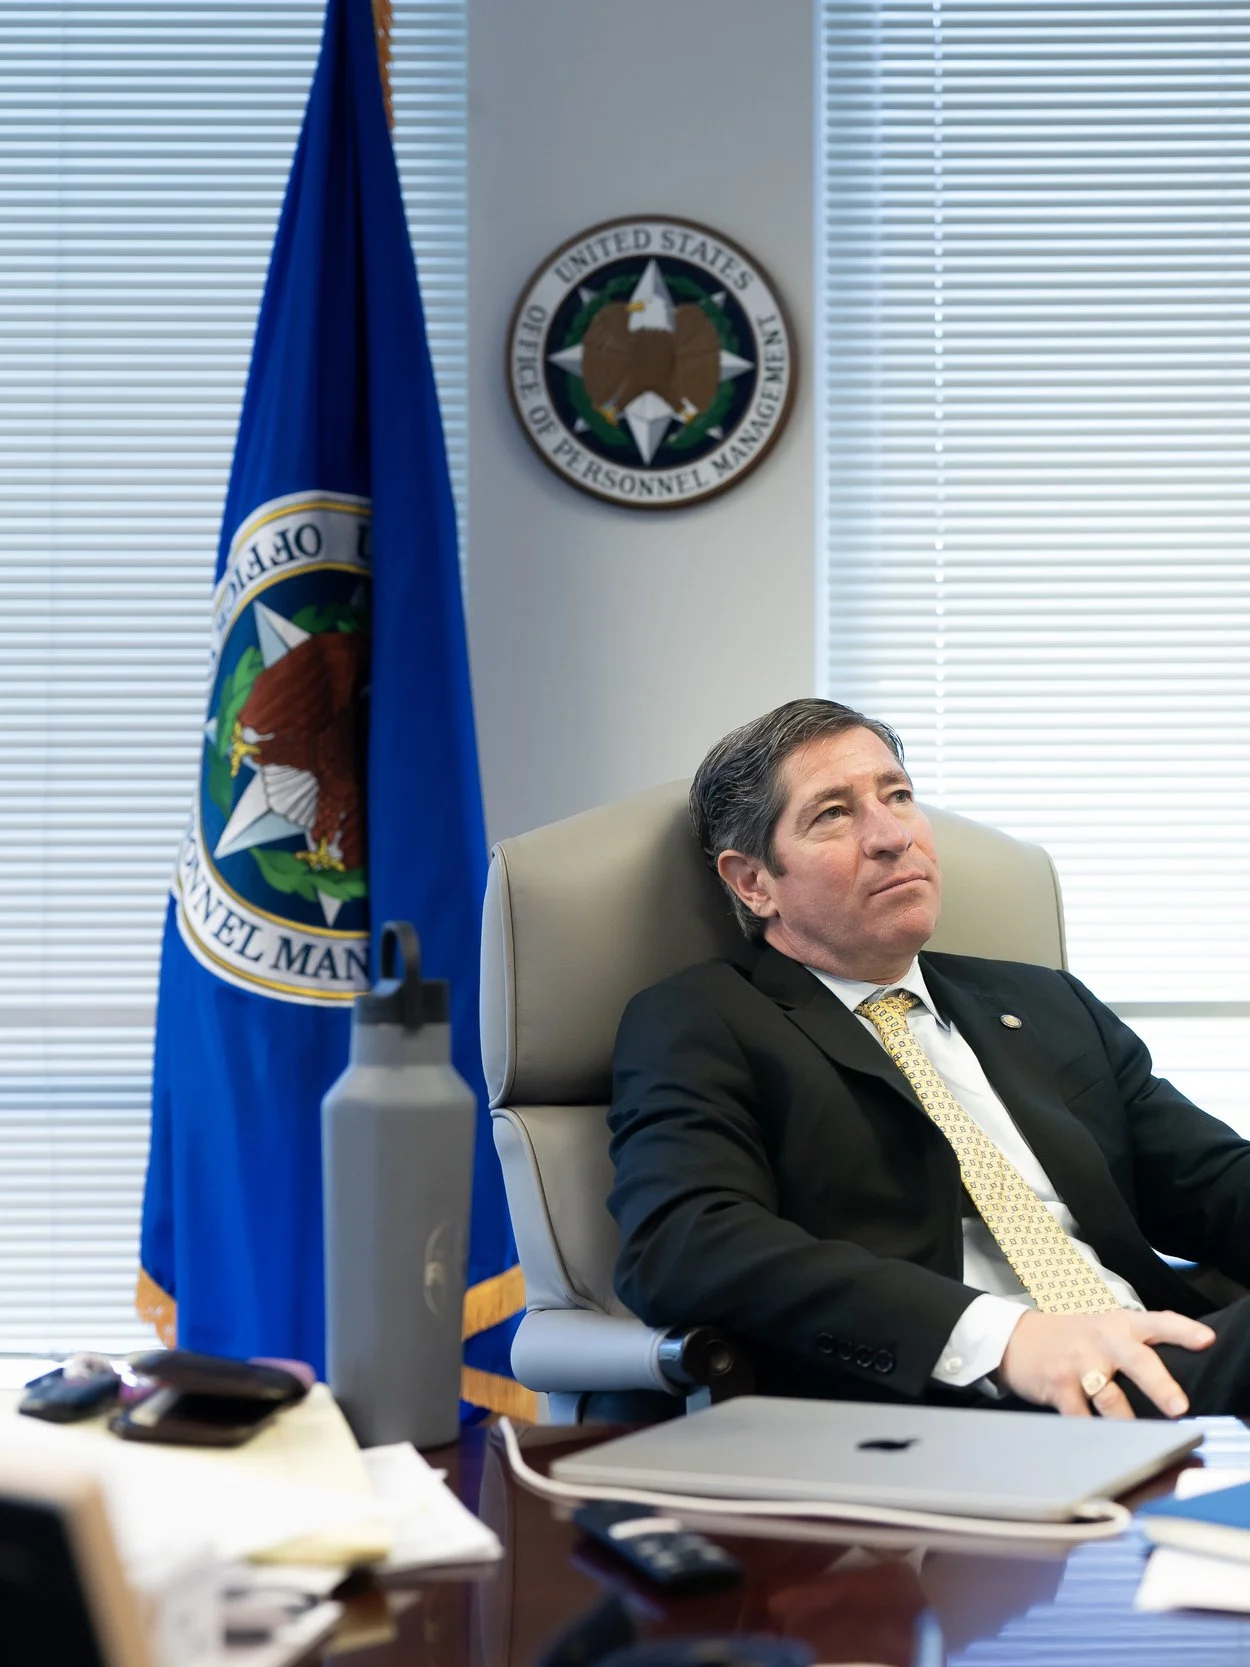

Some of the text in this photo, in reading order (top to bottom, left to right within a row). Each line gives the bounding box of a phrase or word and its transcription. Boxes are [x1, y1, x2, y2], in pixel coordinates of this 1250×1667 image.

[554, 228, 755, 291] UNITED STATES
[516, 304, 785, 498] OFFICE OF PERSONNEL MANAGEMENT
